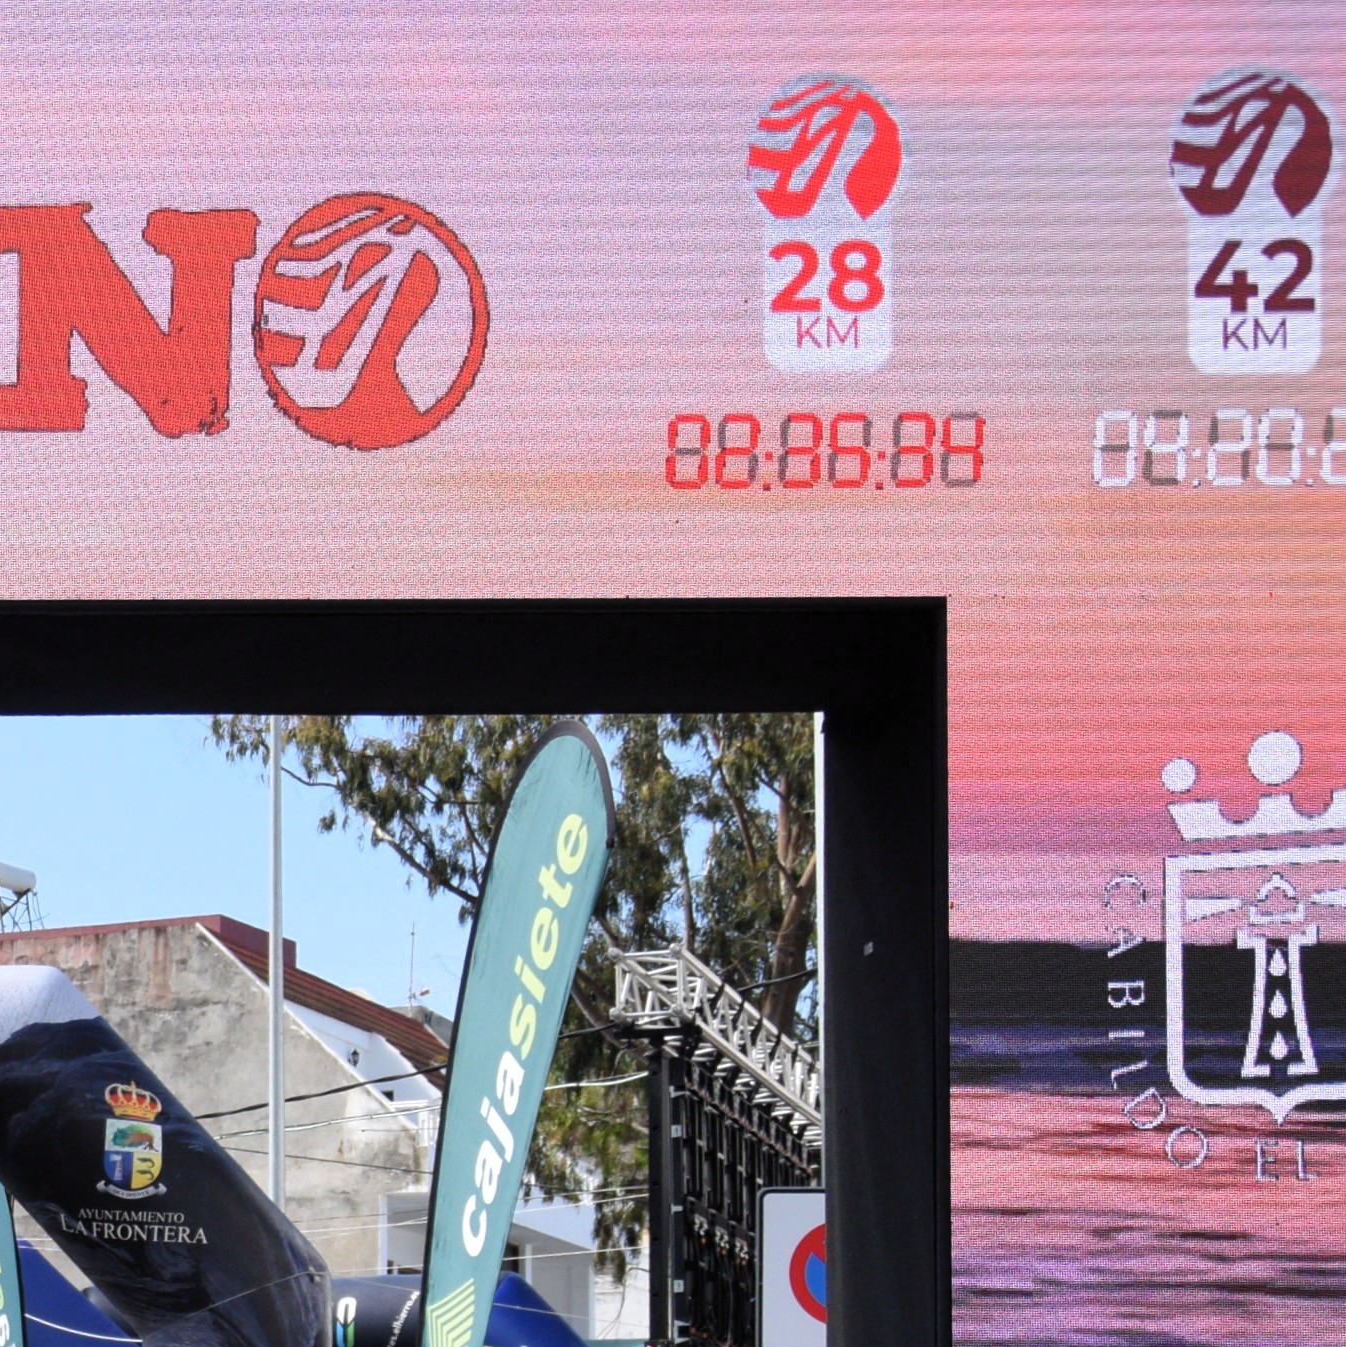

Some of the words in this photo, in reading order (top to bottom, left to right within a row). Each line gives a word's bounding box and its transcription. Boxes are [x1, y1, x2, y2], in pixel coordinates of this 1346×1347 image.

[769, 240, 885, 313] 28
[1194, 239, 1315, 314] 42
[796, 317, 860, 349] KM
[1223, 318, 1288, 350] KM
[462, 812, 588, 1258] cajasiete
[1104, 874, 1209, 1168] CABILDO
[1255, 1139, 1319, 1182] EL
[60, 1213, 88, 1236] LA
[92, 1222, 208, 1244] FRONTERA
[78, 1208, 185, 1224] AYUNTAMIENTO
